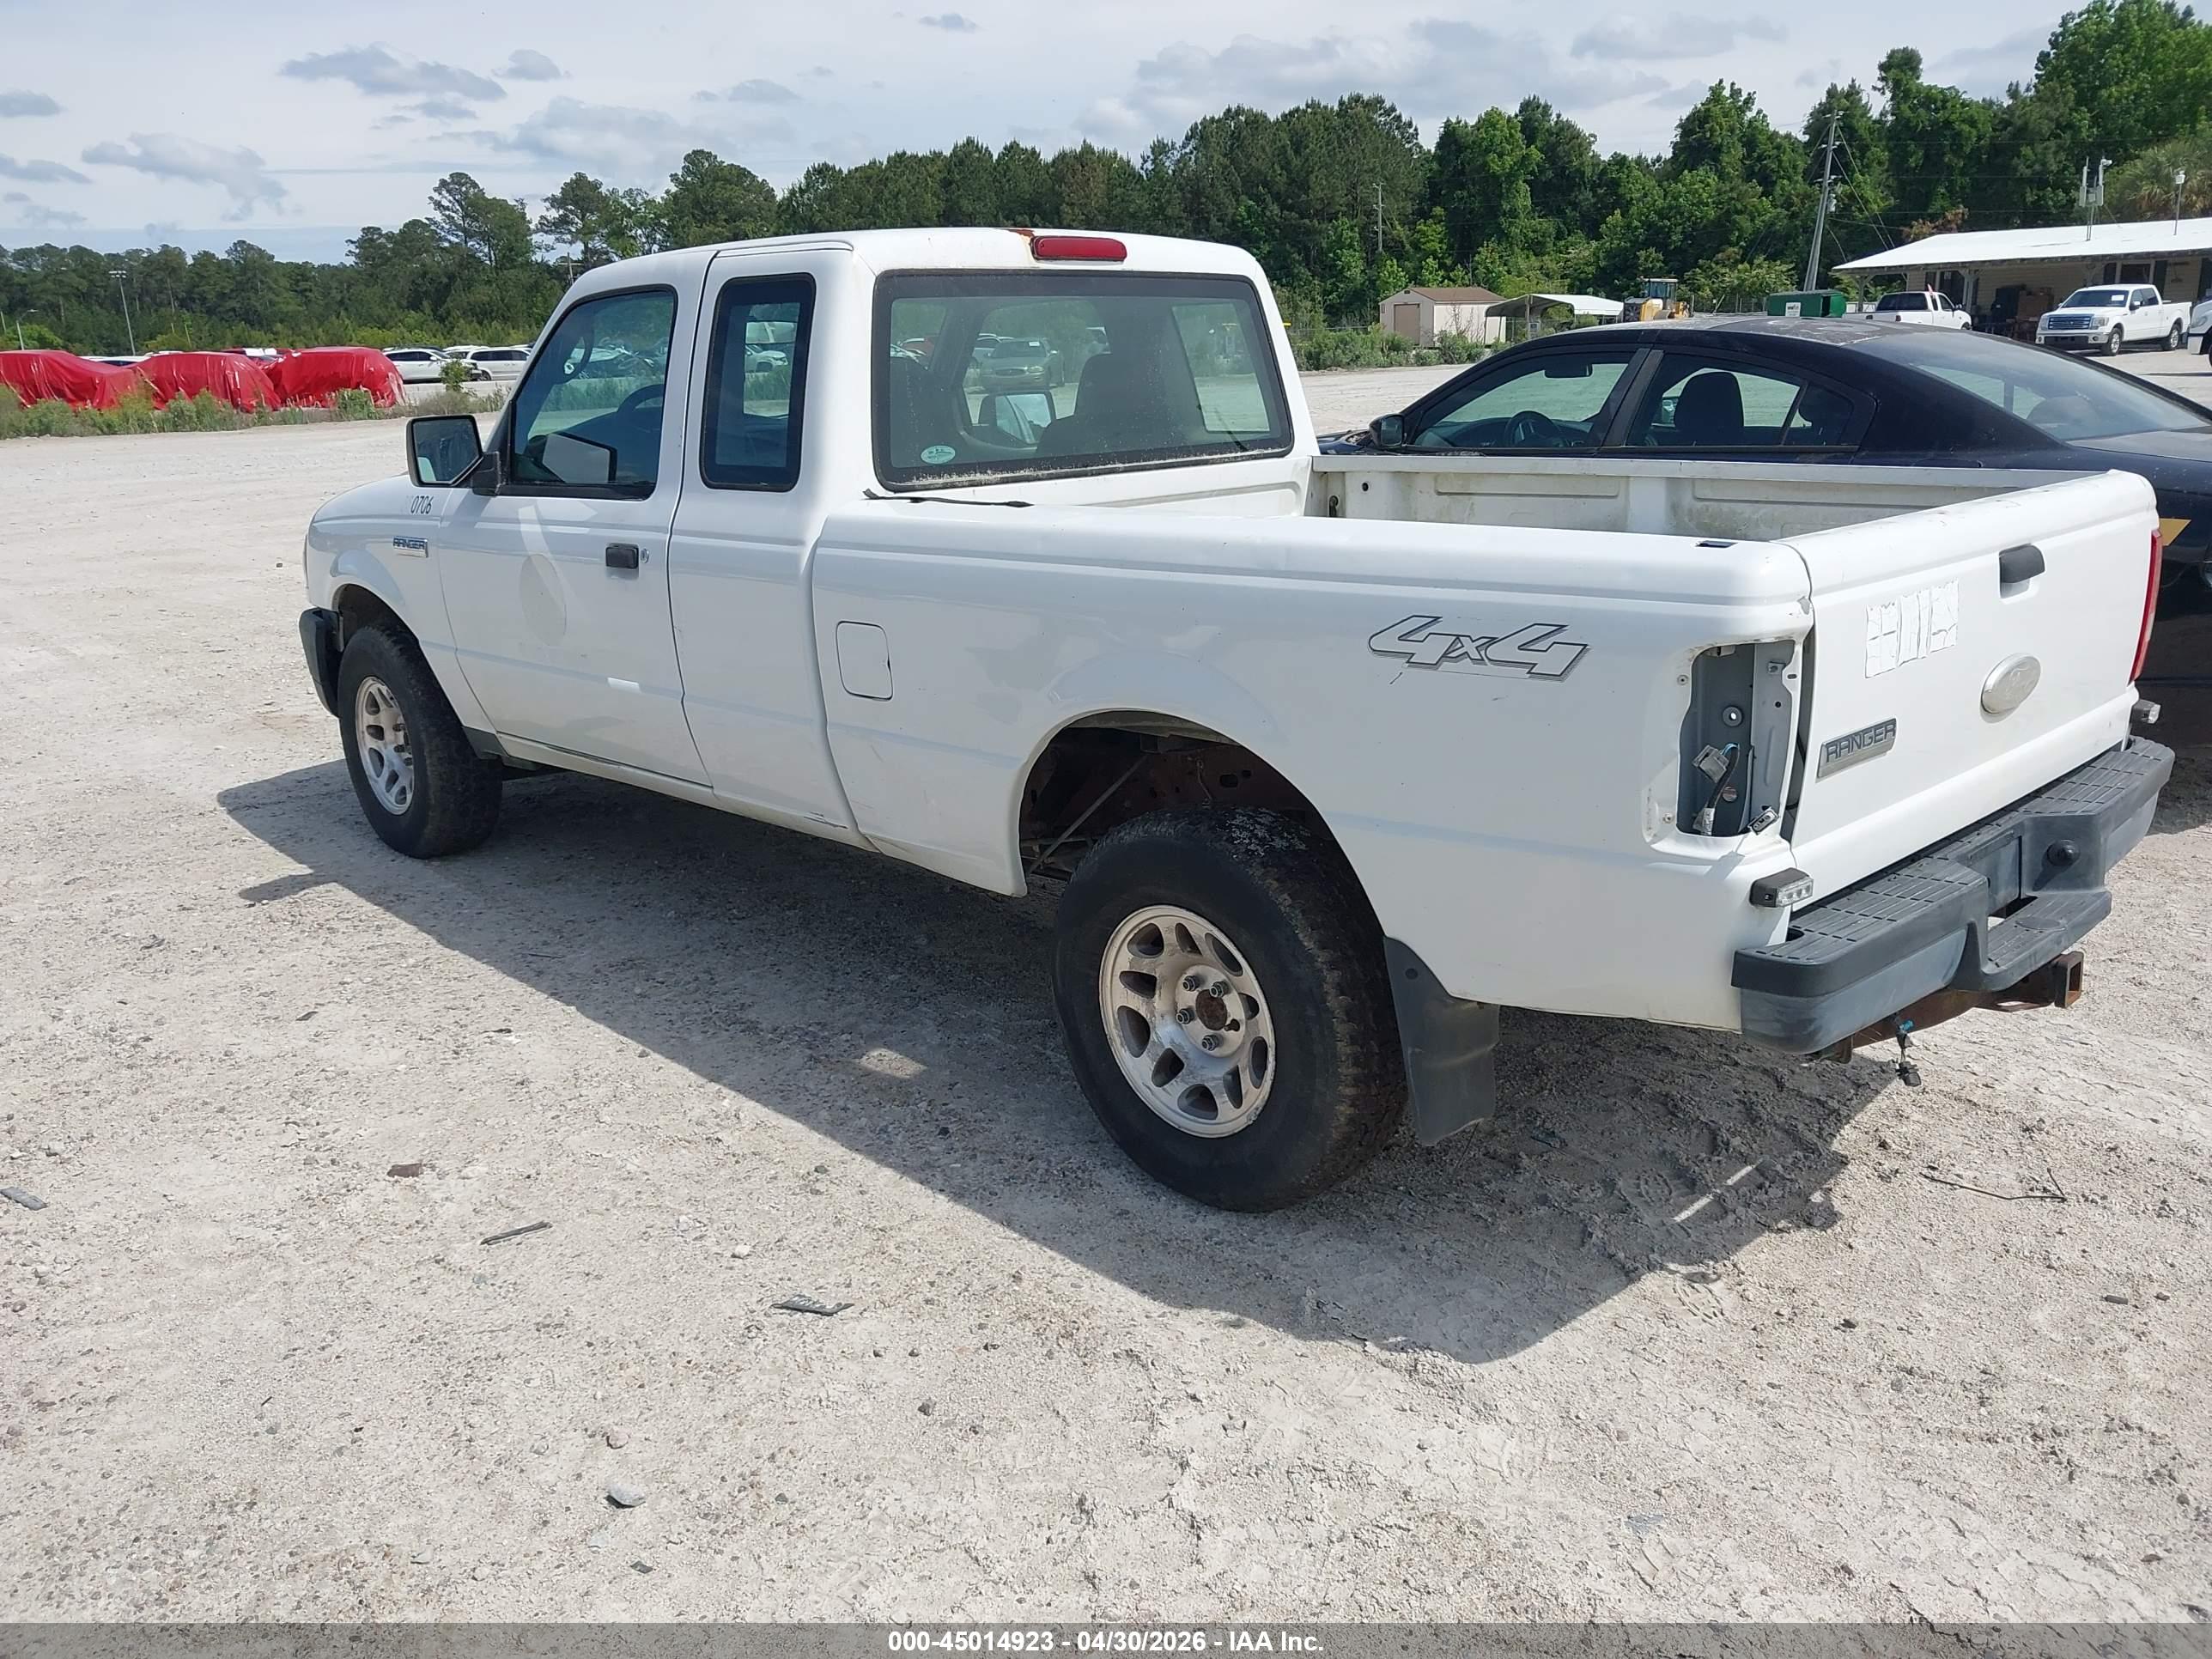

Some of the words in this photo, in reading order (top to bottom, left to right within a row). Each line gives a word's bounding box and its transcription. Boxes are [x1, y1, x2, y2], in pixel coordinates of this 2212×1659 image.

[410, 495, 434, 514] 0706
[1369, 614, 1589, 681] 4x4
[1825, 720, 1896, 763] RANGER
